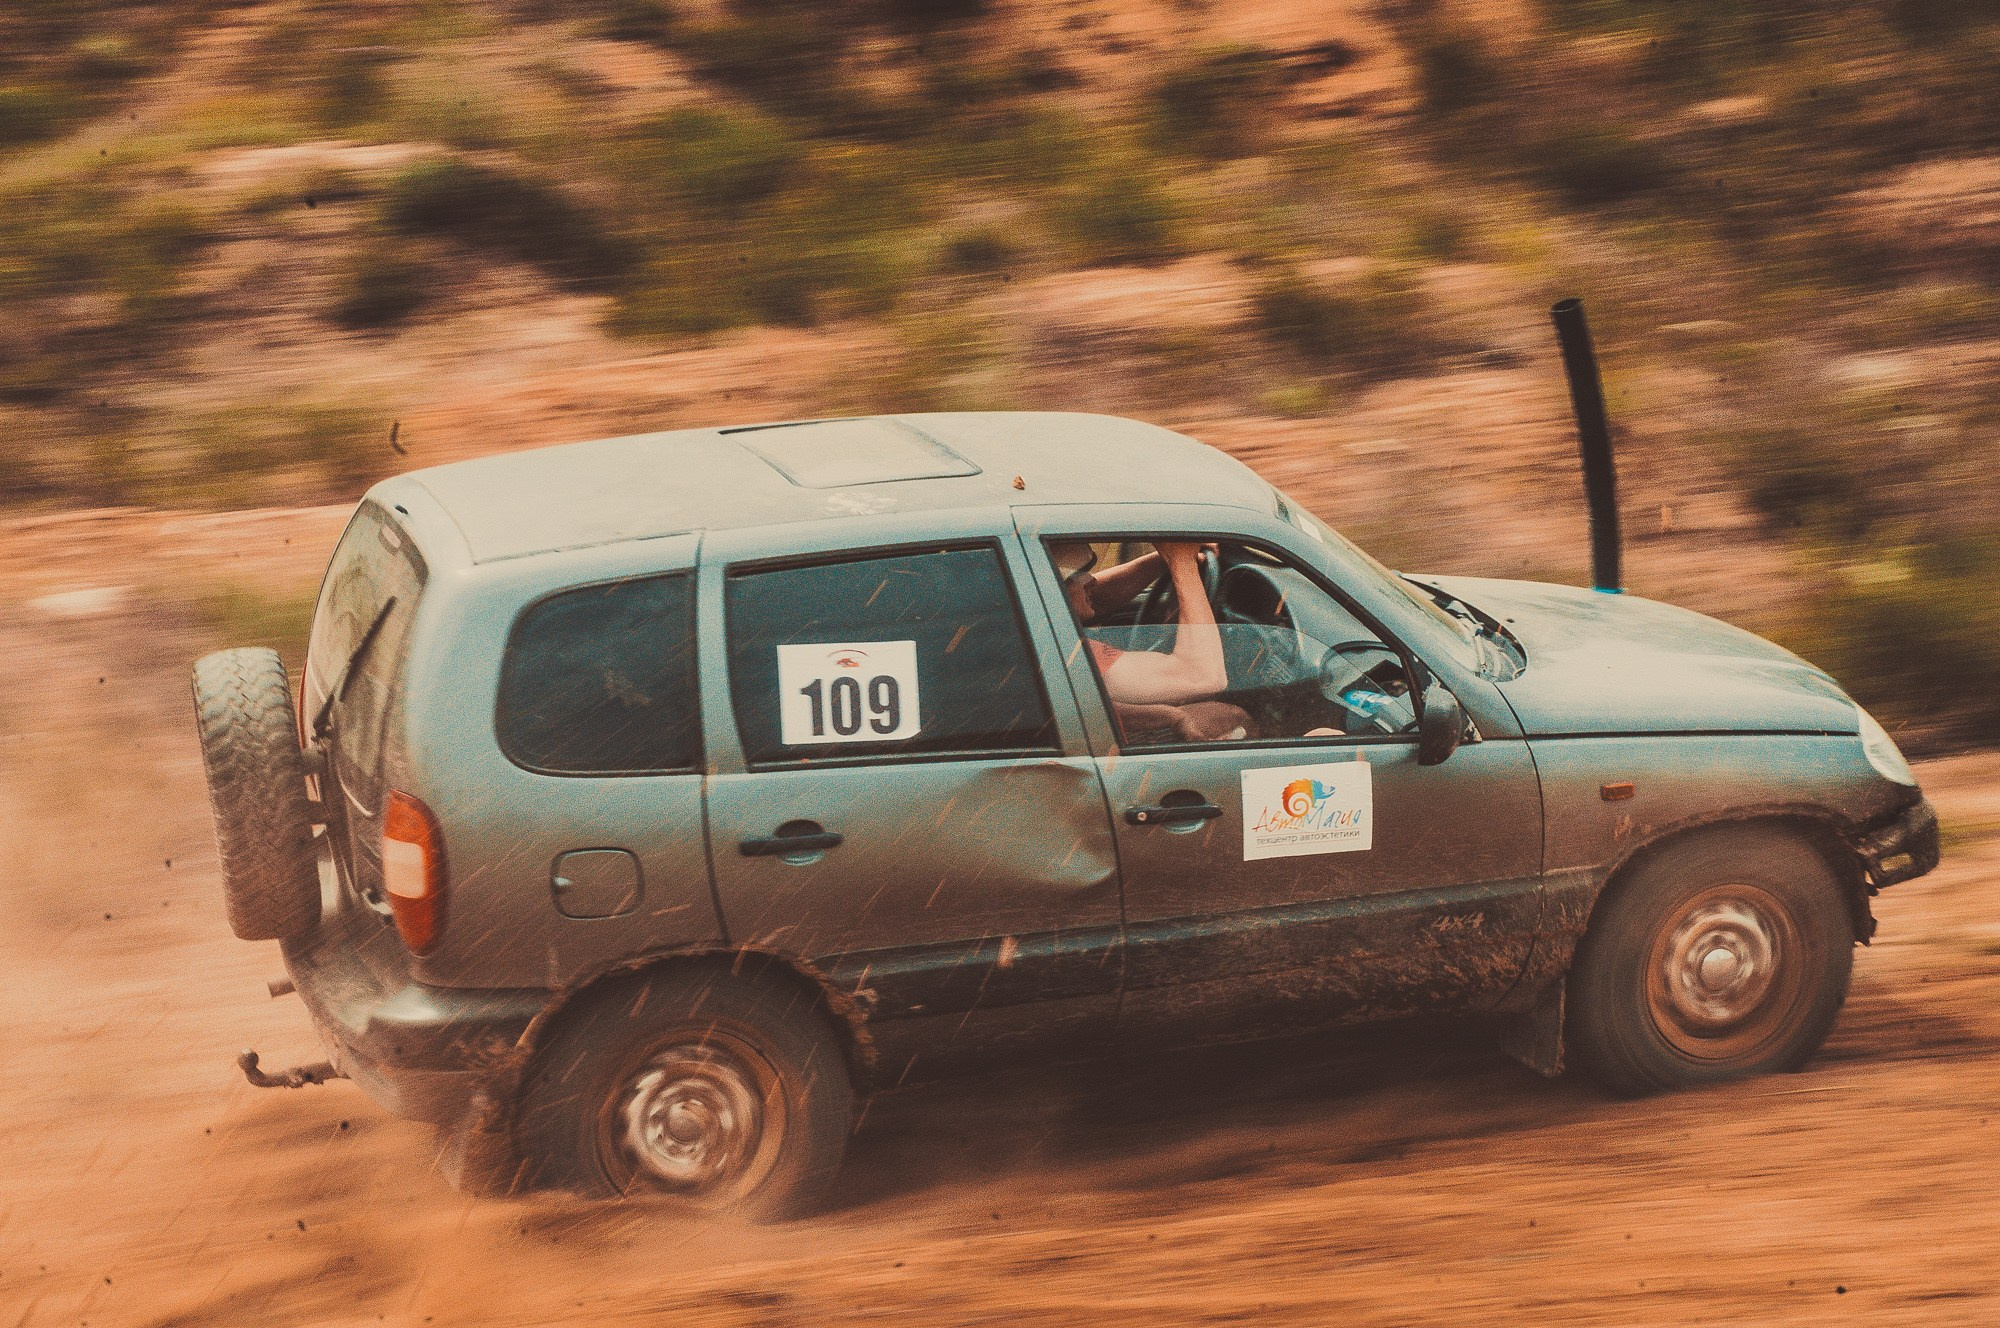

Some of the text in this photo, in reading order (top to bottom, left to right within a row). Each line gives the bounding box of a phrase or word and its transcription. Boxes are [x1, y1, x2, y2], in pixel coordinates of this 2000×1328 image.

[800, 675, 900, 736] 109
[1256, 830, 1360, 846] техцентр автоэстетики
